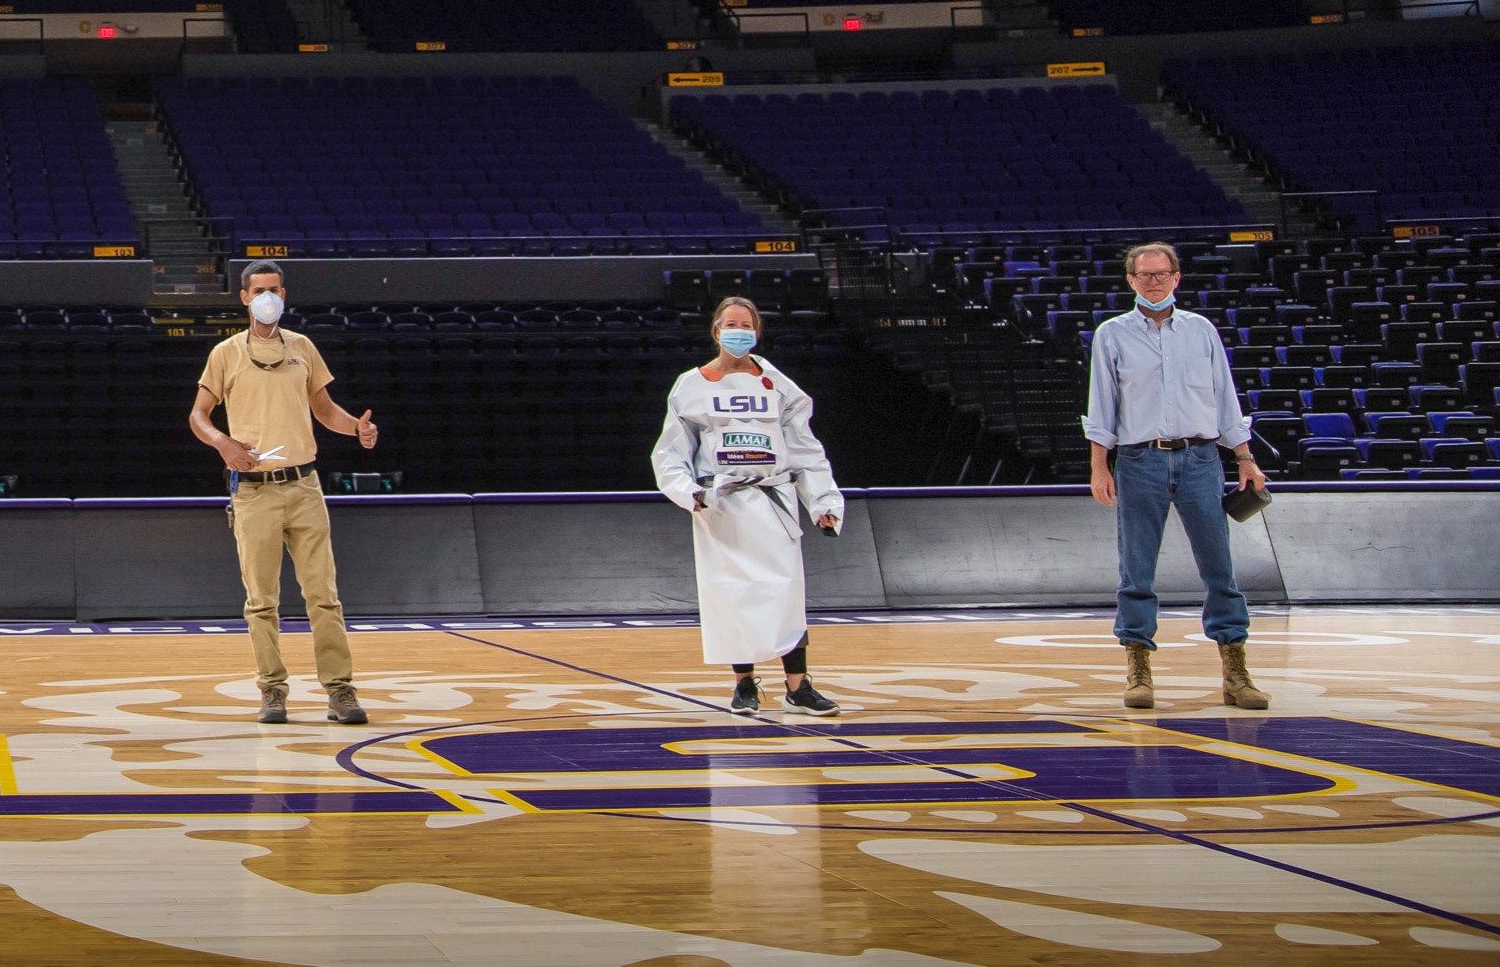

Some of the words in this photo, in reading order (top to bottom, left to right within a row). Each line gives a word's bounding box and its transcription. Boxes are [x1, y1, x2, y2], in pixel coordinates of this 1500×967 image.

[768, 242, 792, 251] 104
[114, 249, 131, 257] 103
[260, 247, 285, 256] 104
[168, 328, 184, 336] 103
[713, 396, 768, 412] LSU
[728, 435, 767, 447] LAMAR
